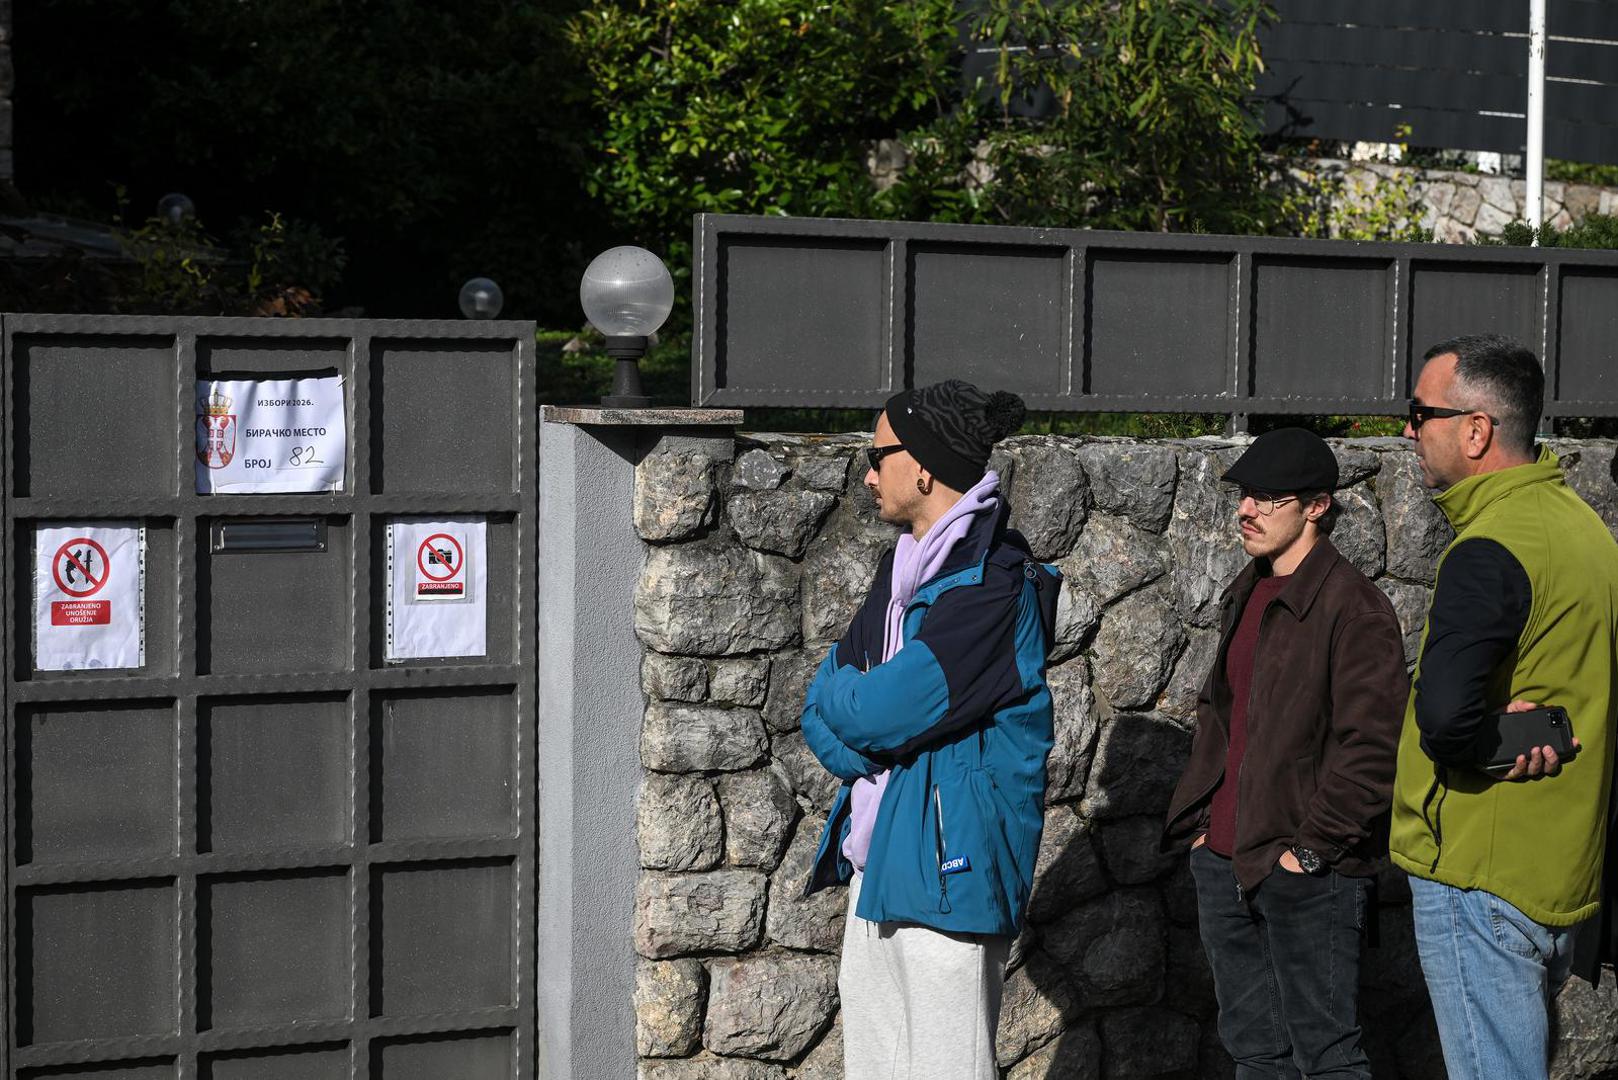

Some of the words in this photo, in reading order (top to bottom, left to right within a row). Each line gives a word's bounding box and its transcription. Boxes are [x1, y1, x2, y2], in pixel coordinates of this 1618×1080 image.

[257, 399, 291, 407] ИЗБОРИ
[292, 399, 314, 407] 2026.
[245, 428, 292, 438] БИРАЧКО
[293, 427, 327, 437] МЕСТО
[244, 459, 272, 469] БРОЈ
[289, 445, 324, 467] 82
[941, 857, 964, 871] ABCD
